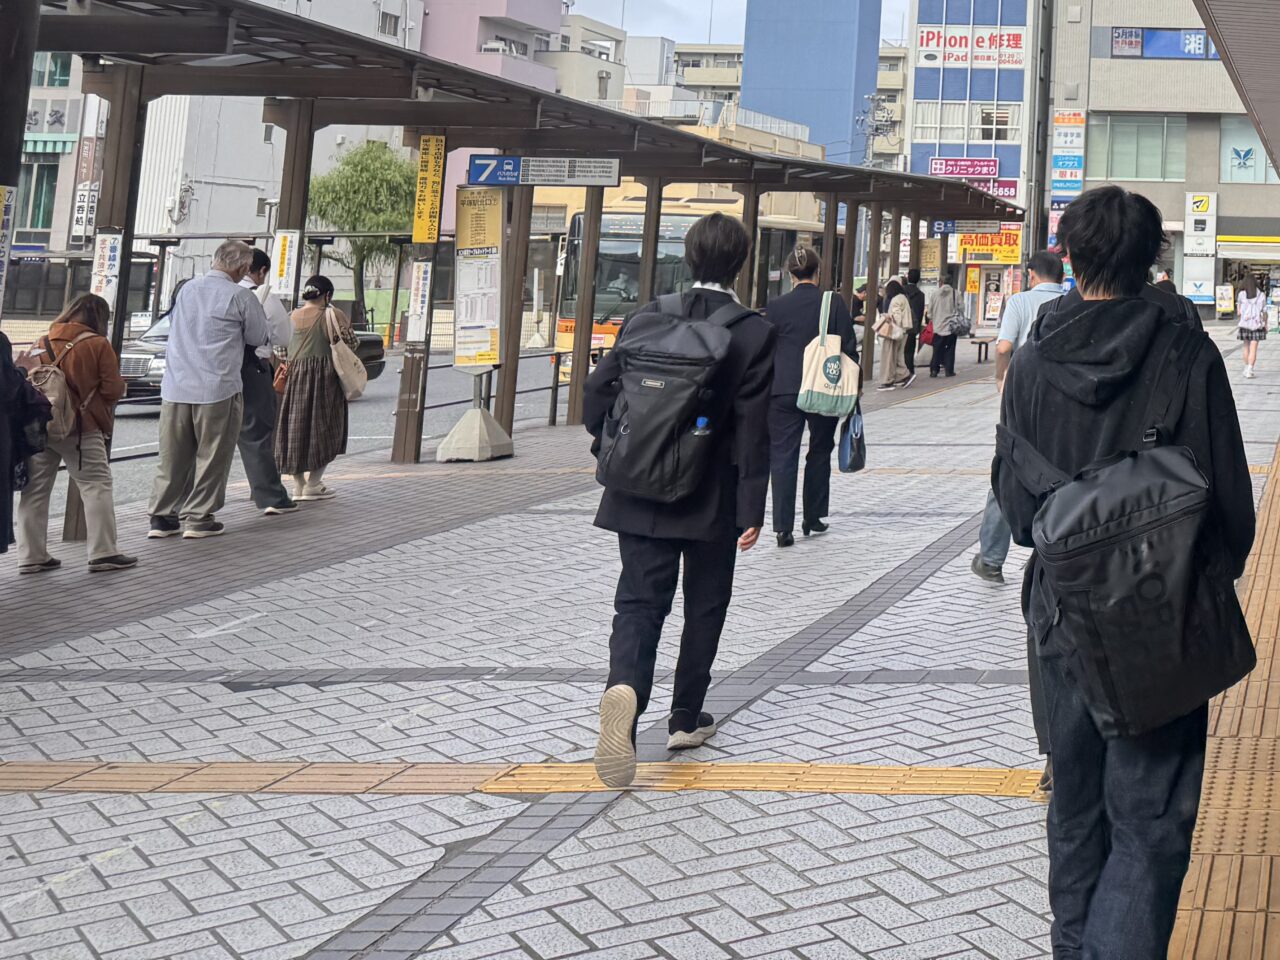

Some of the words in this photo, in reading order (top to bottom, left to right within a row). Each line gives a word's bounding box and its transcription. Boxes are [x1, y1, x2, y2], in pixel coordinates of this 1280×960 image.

[475, 160, 497, 181] 7
[945, 166, 996, 174] クリニックまり
[75, 193, 86, 226] 立呑処
[934, 221, 945, 232] 8
[960, 232, 1019, 246] 高価買取
